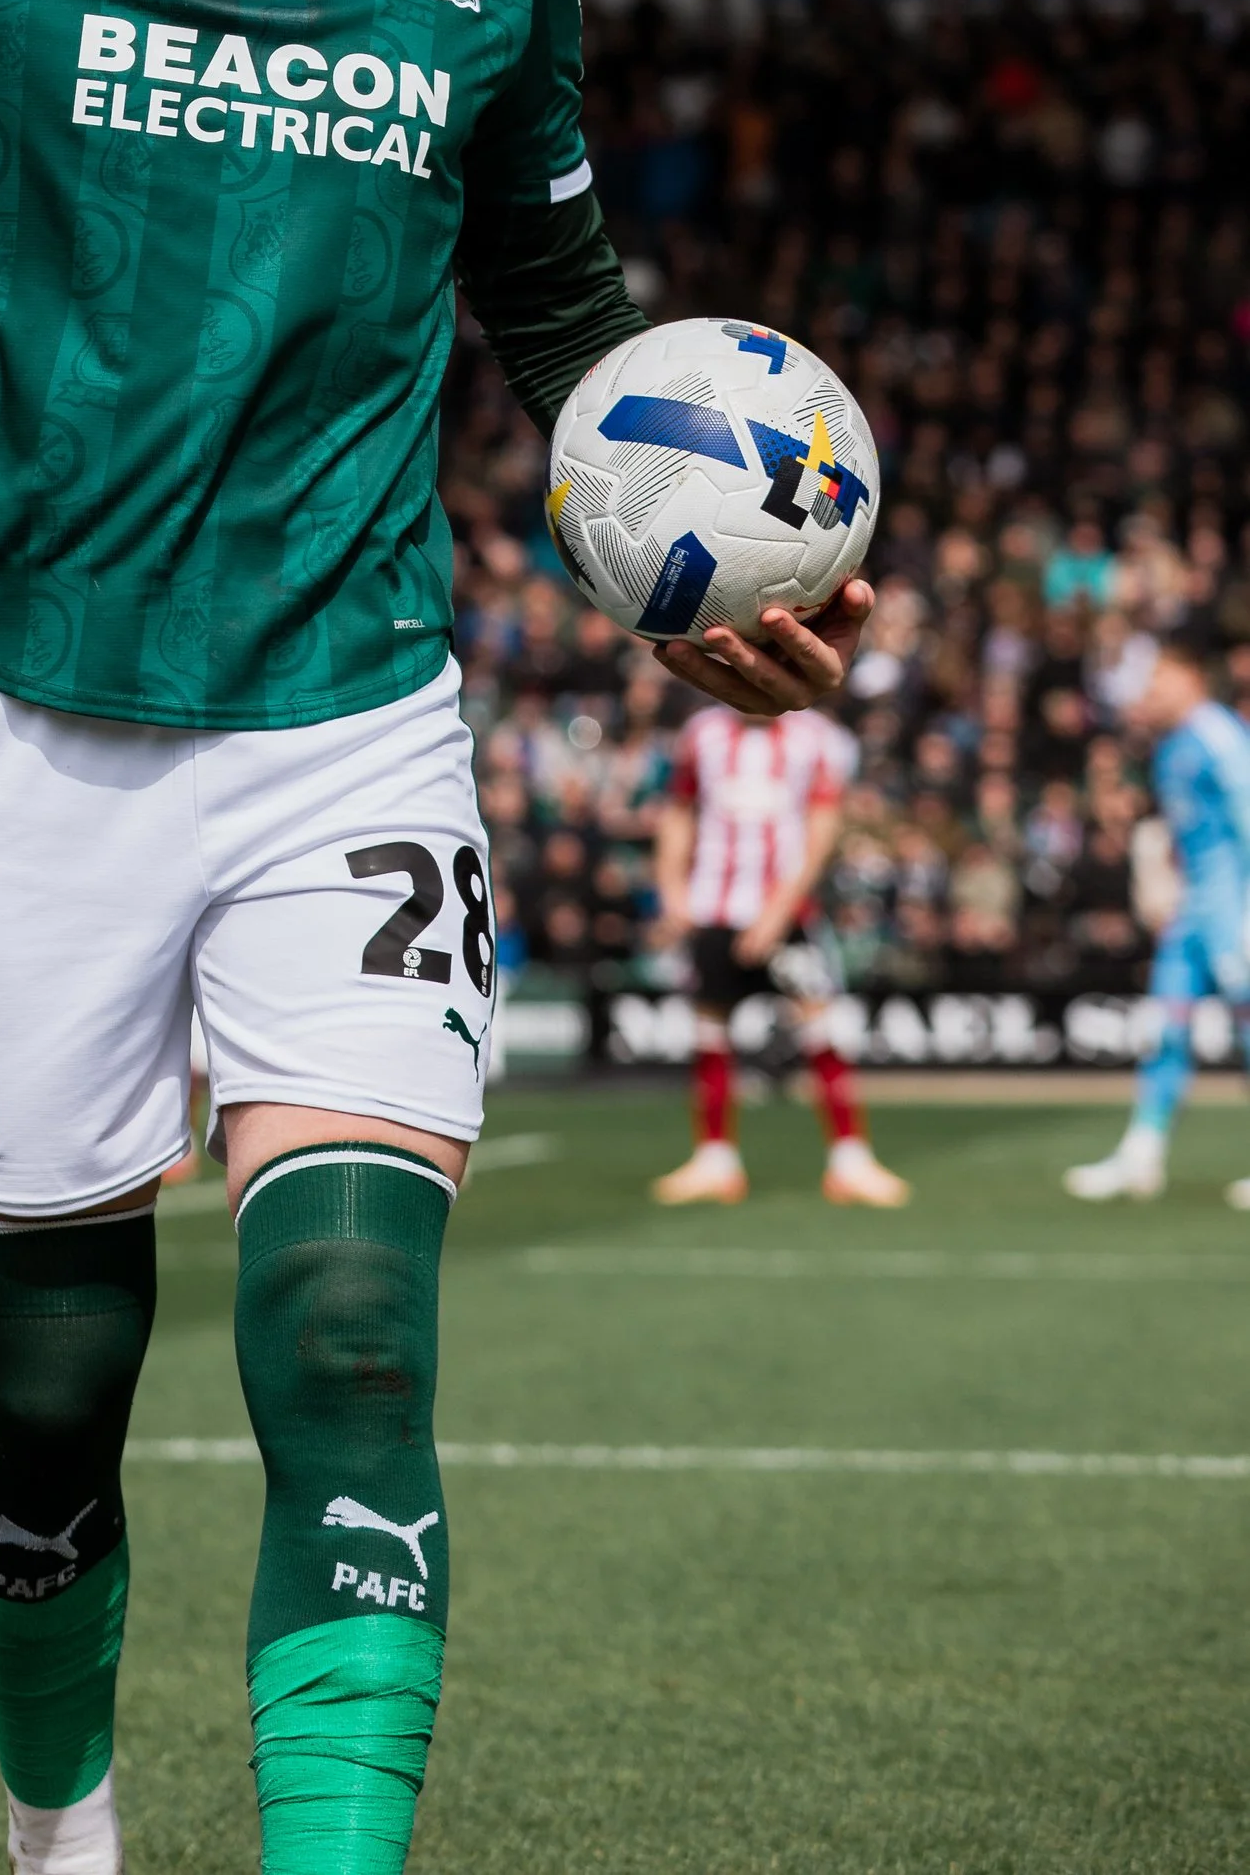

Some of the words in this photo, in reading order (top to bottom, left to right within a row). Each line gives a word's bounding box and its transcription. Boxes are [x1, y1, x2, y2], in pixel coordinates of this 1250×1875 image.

[77, 13, 451, 128] BEACON
[71, 78, 432, 179] ELECTRICAL
[393, 618, 426, 630] DRYCELL
[344, 841, 494, 998] 28
[403, 967, 420, 978] EFL
[331, 1561, 427, 1612] PAFC
